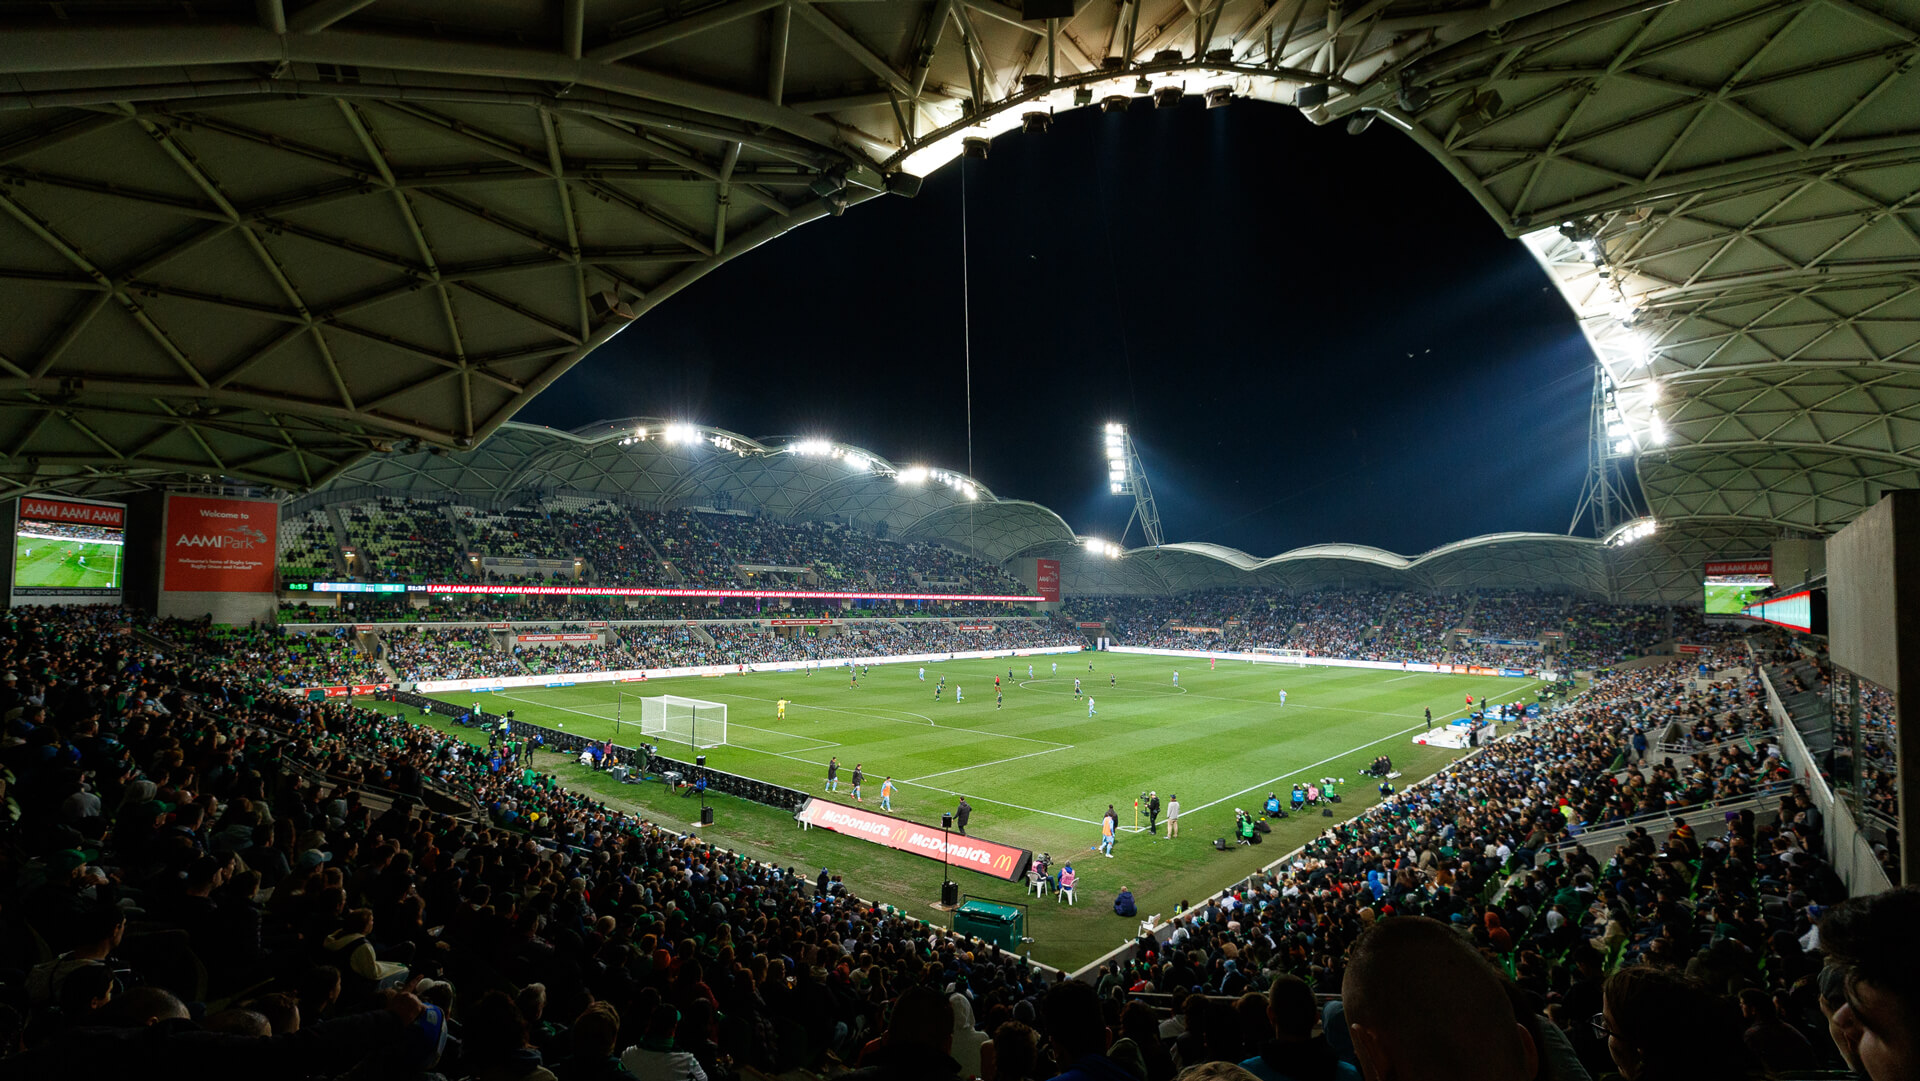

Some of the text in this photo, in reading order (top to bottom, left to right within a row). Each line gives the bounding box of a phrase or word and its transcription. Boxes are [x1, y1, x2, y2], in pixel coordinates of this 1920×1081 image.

[25, 503, 120, 523] AAMI AAMI AAMI
[201, 509, 238, 519] Welcome
[176, 534, 255, 550] AAMI Park
[821, 810, 890, 837] McDonald's
[908, 833, 991, 865] McDonald's
